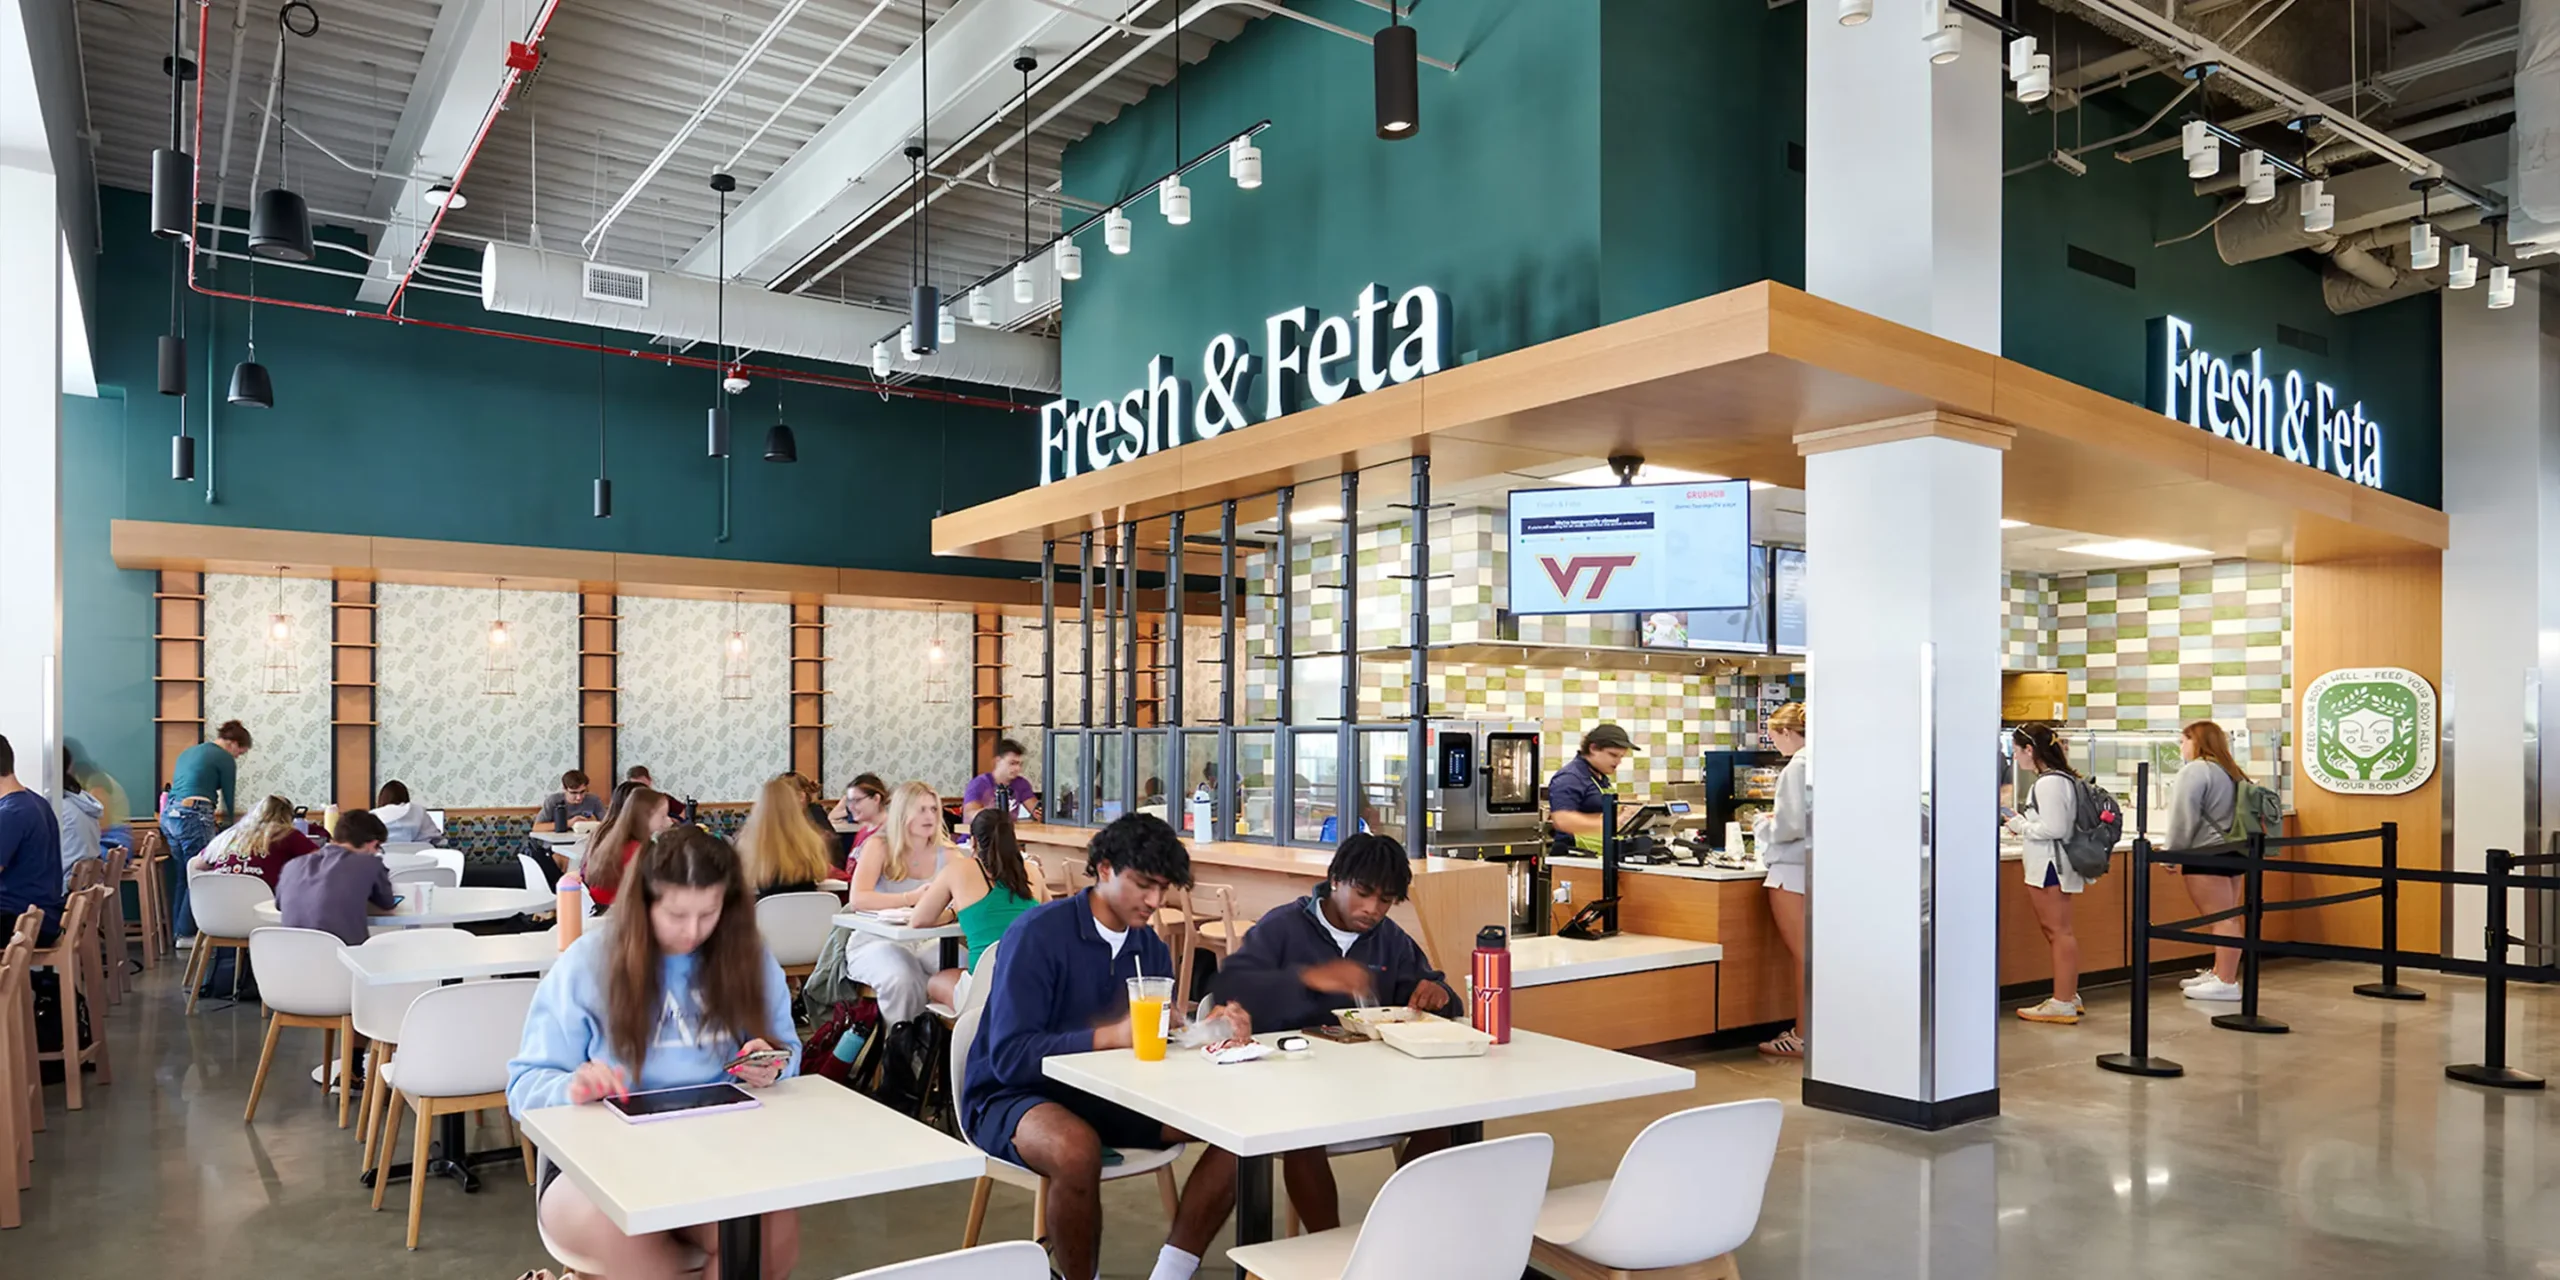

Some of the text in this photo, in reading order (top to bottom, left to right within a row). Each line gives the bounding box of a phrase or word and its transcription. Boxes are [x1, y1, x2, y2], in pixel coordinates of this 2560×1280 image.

[1040, 282, 1443, 486] Fresh & Feta
[2165, 314, 2382, 489] Fresh & Feta
[1686, 490, 1725, 500] GRUBHUB
[1536, 553, 1640, 602] VT
[2306, 672, 2359, 753] FEED YOUR BODY WELL
[2374, 671, 2430, 753] FEED YOUR BODY WELL
[2309, 764, 2428, 791] FEED YOUR BODY WELL
[1474, 986, 1504, 1003] VT
